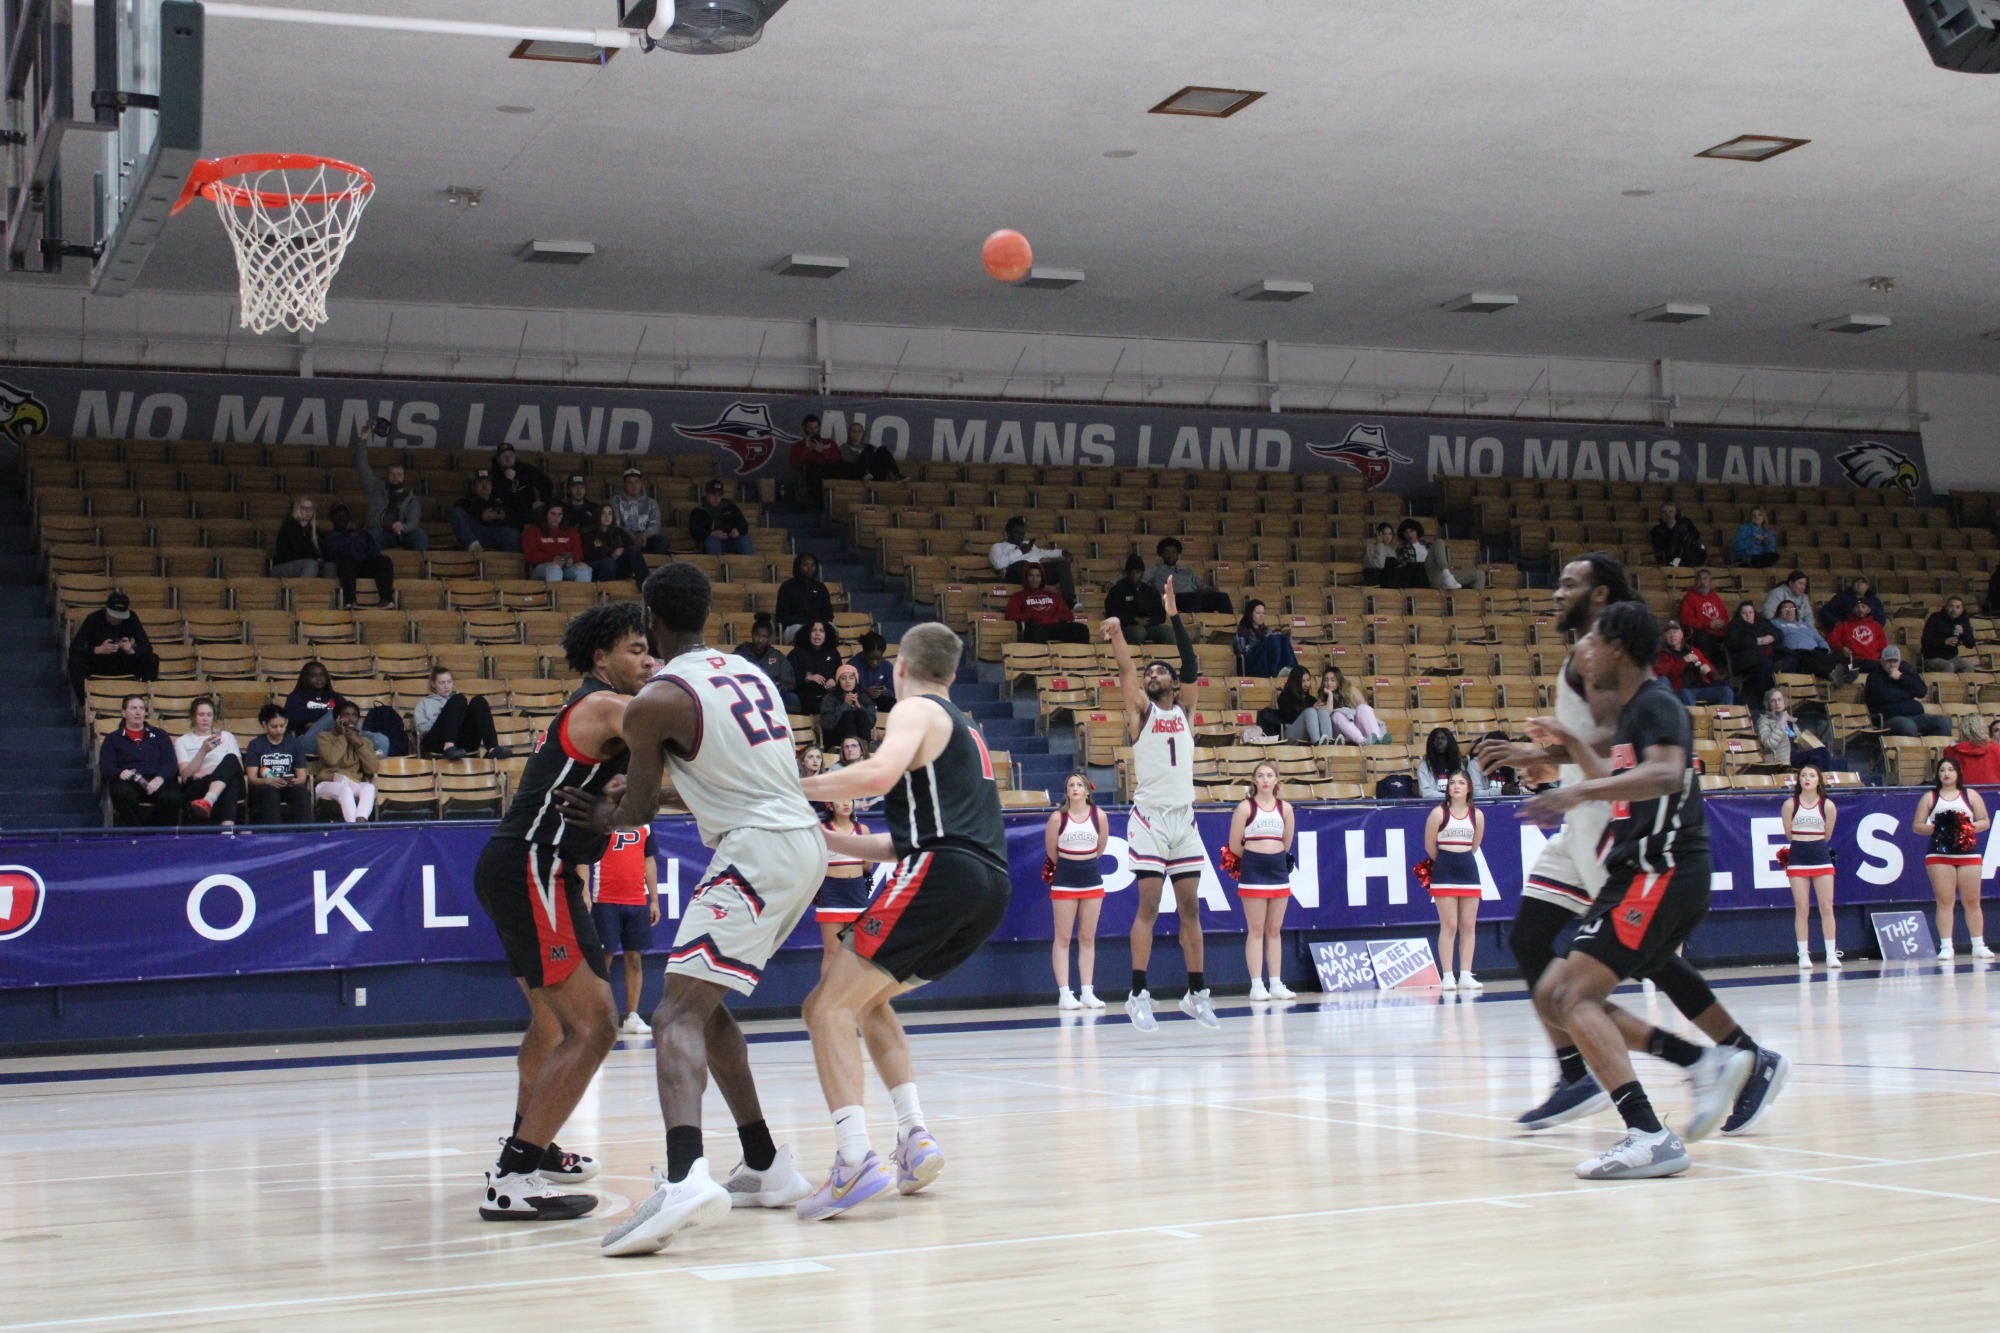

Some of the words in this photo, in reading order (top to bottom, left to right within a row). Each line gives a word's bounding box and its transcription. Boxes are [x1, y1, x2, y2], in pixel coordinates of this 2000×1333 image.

[72, 389, 189, 441] NO
[210, 395, 441, 449] MANS
[463, 402, 653, 455] LAND
[930, 419, 1116, 467] MANS
[1136, 425, 1292, 472] LAND
[1427, 435, 1504, 480] NO
[1522, 438, 1681, 484] MANS
[1696, 444, 1821, 487] LAND
[708, 674, 787, 747] 22
[1167, 736, 1177, 767] 1
[612, 830, 640, 850] P
[864, 915, 883, 937] M
[1881, 916, 1919, 942] THIS
[550, 945, 568, 961] M
[1320, 943, 1347, 960] NO
[1386, 942, 1412, 962] GET
[1902, 937, 1919, 955] IS
[1317, 952, 1372, 979] MAN'S
[1378, 947, 1432, 986] ROWDY
[1325, 967, 1375, 992] LAND
